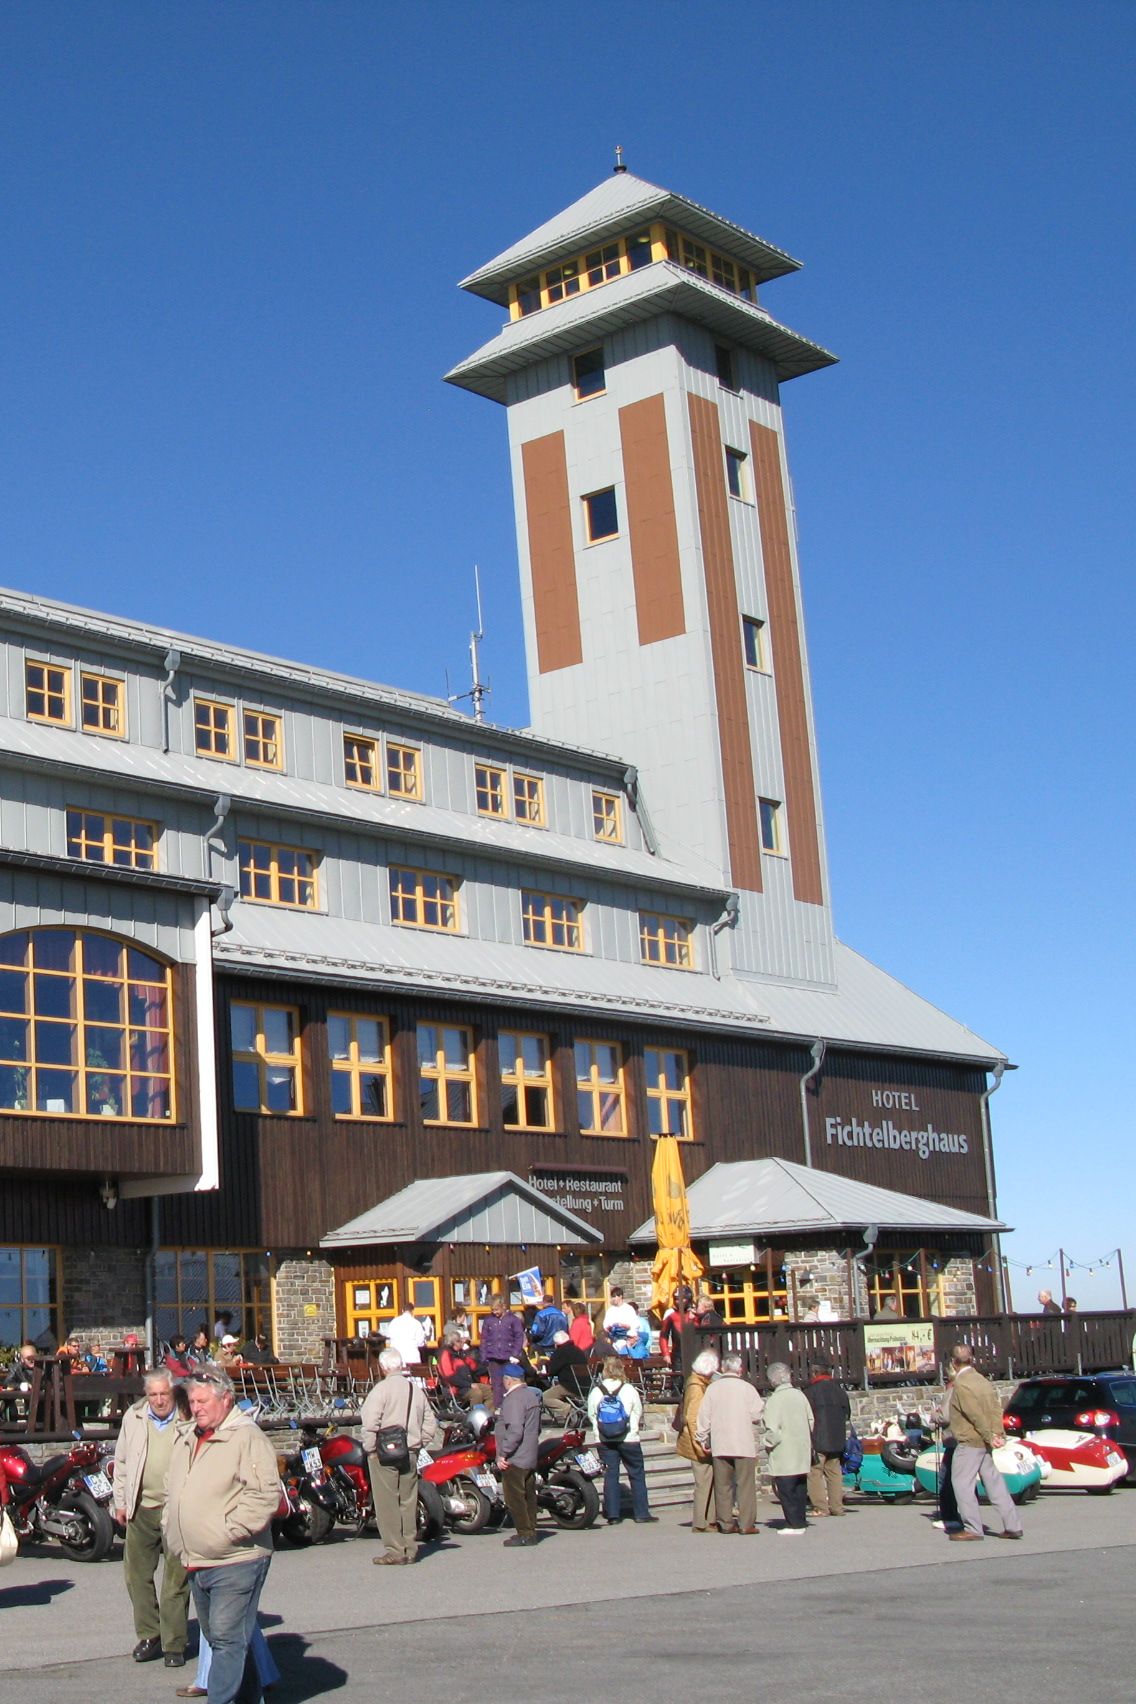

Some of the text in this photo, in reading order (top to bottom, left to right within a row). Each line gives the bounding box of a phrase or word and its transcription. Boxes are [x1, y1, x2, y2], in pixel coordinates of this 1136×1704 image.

[872, 1089, 920, 1111] HOTEL
[825, 1116, 969, 1160] Fichtelberghaus
[528, 1175, 558, 1191] Hotel
[566, 1178, 623, 1193] Restaurant
[599, 1196, 624, 1211] Turm
